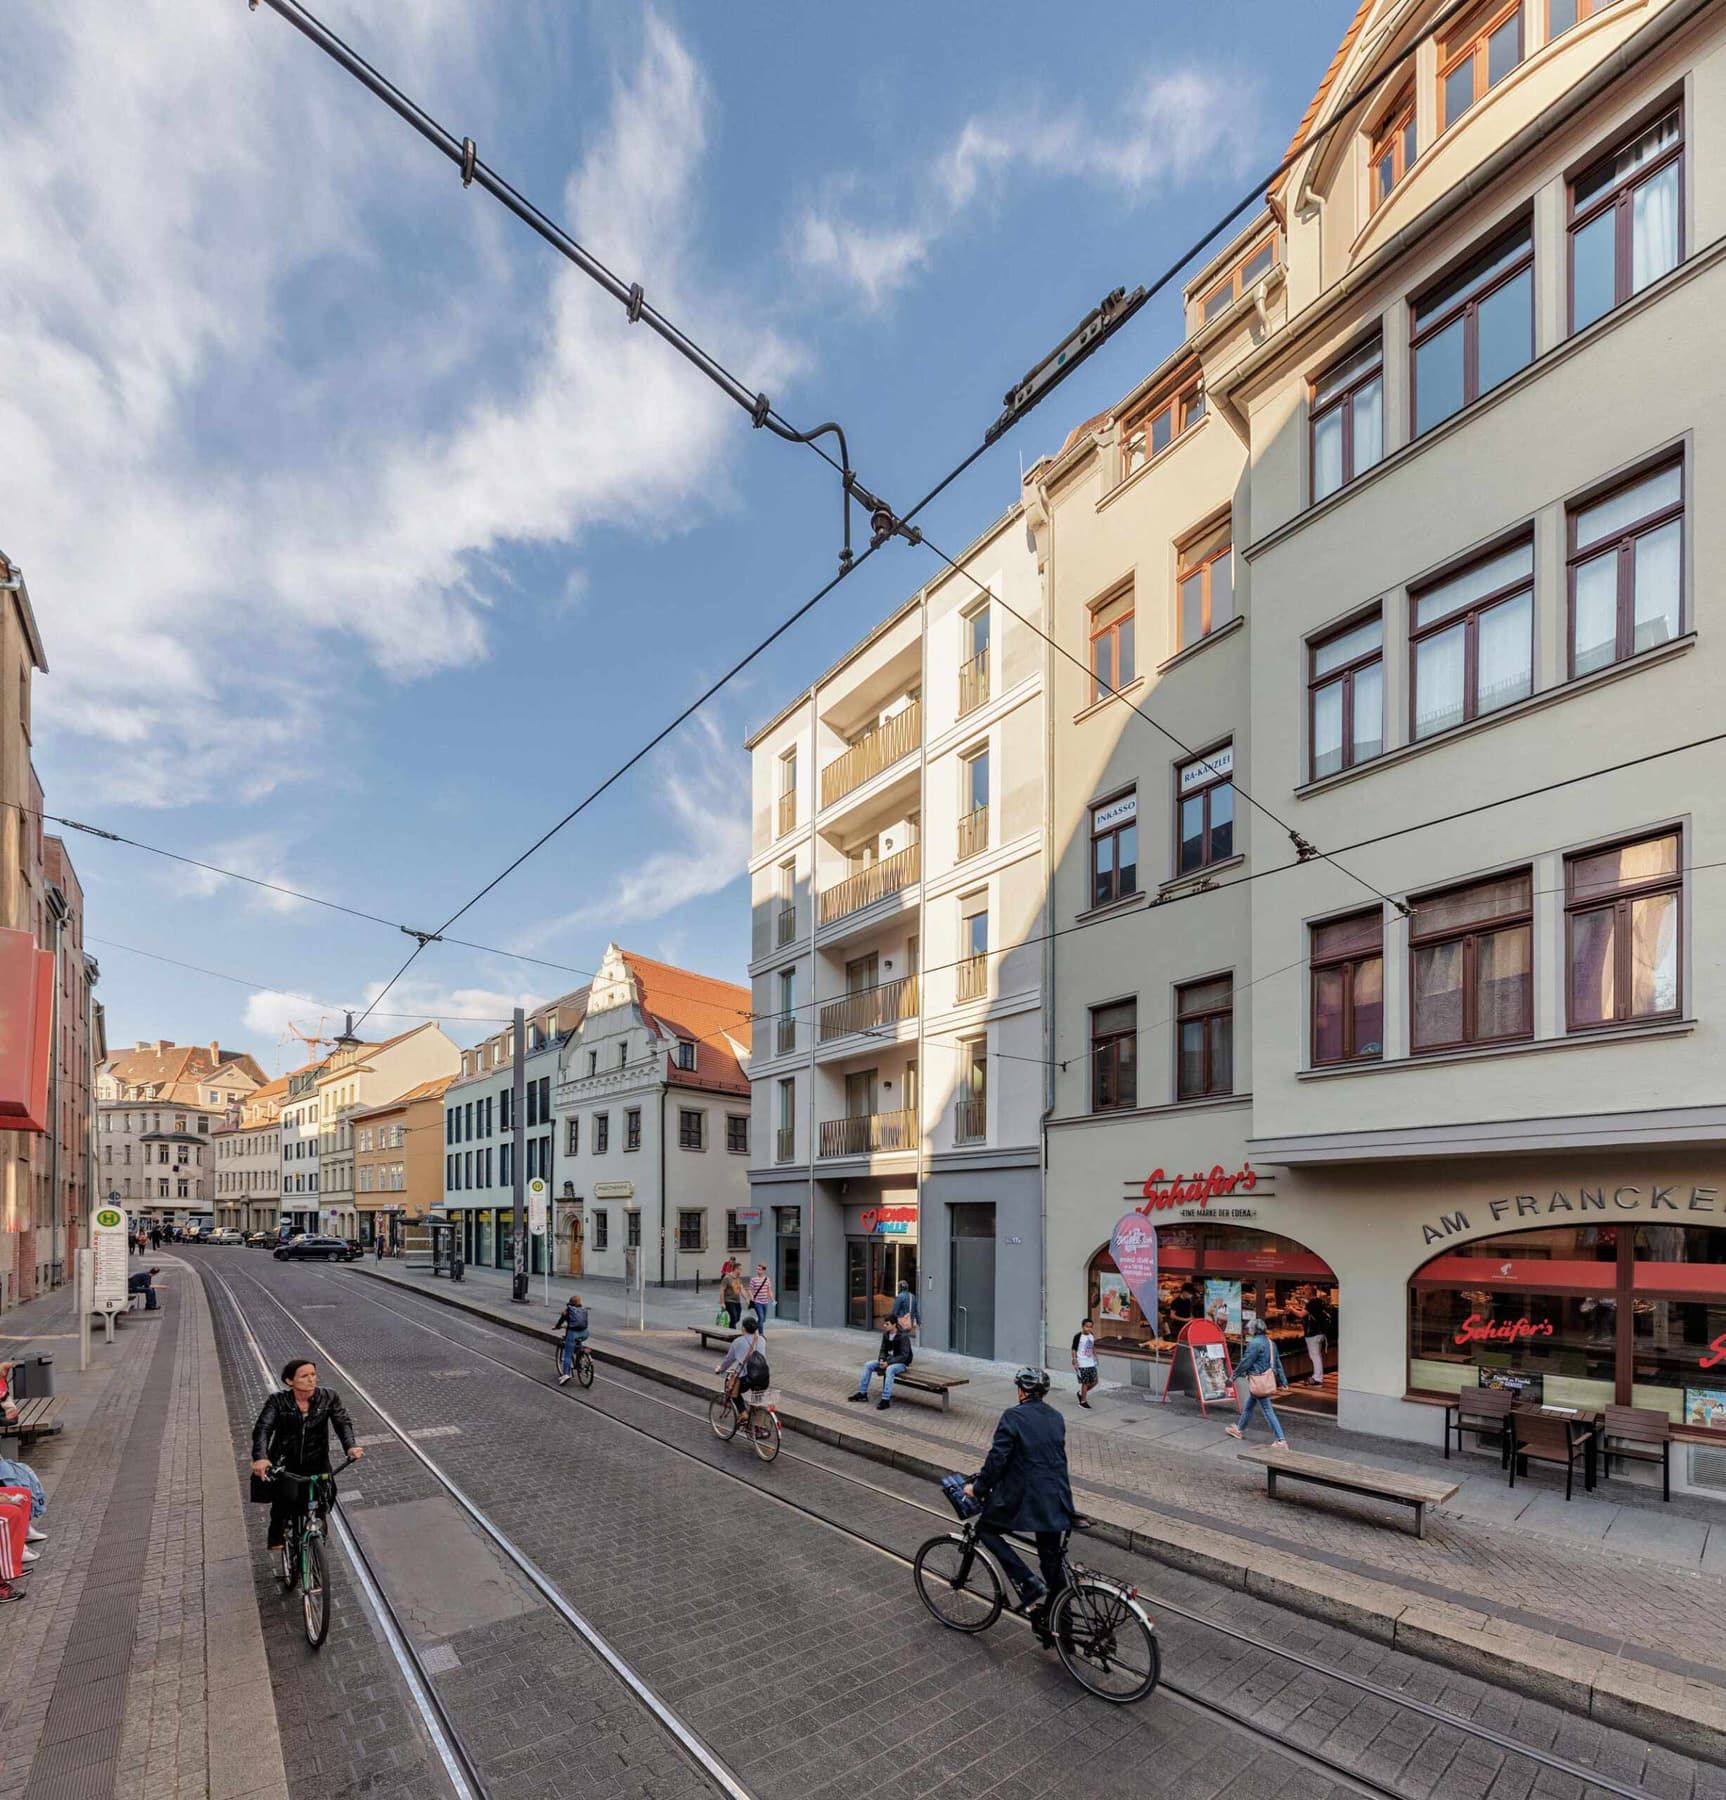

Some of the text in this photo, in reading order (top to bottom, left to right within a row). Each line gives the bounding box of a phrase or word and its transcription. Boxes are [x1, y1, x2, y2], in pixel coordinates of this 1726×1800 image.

[1184, 754, 1231, 783] RA-KANZLEI
[1097, 800, 1136, 825] INKASSO
[1135, 1162, 1257, 1216] Schäfer's
[1182, 1209, 1195, 1217] EINE
[1197, 1209, 1216, 1217] MARKE
[1218, 1209, 1229, 1217] DER
[1421, 1184, 1726, 1245] AM FRANCKE
[106, 1301, 113, 1309] B
[1455, 1313, 1554, 1345] Schäfer's
